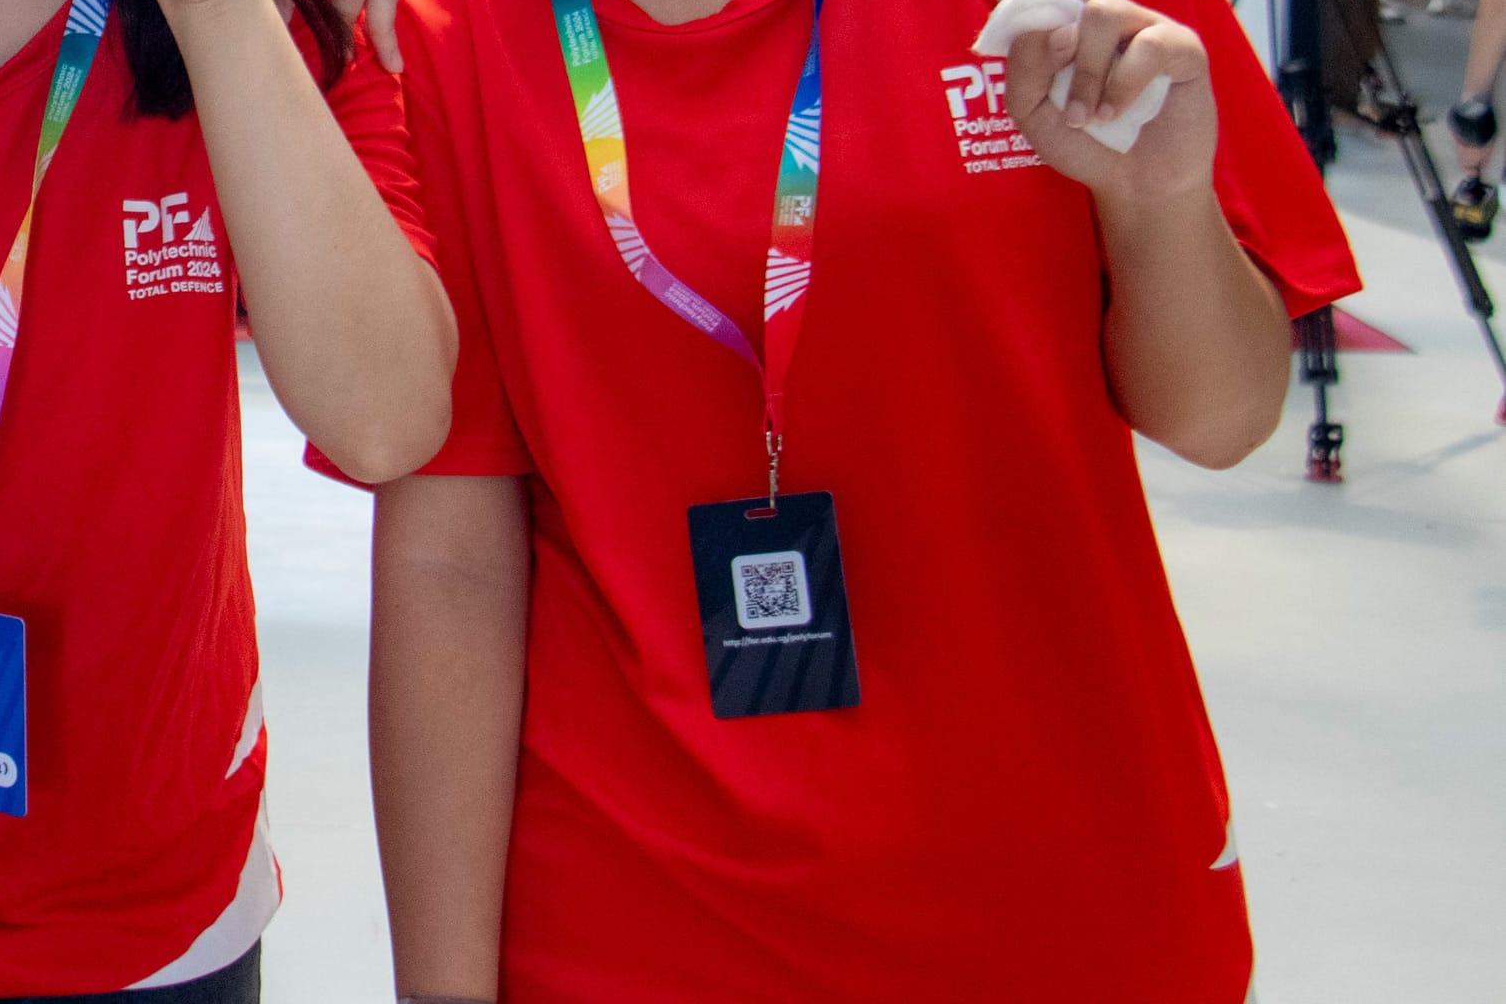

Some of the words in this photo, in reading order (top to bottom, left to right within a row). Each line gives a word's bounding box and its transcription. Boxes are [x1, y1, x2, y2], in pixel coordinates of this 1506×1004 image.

[570, 10, 583, 32] 2024
[940, 62, 1006, 118] PF
[959, 139, 1009, 157] Forum
[964, 160, 1001, 174] TOTAL
[1001, 154, 1041, 169] DEFENC
[123, 192, 190, 248] PF
[125, 242, 217, 266] Polytechnic
[126, 265, 183, 285] Forum
[187, 261, 221, 277] 2024
[128, 284, 168, 300] TOTAL
[171, 281, 224, 293] DEFENCE
